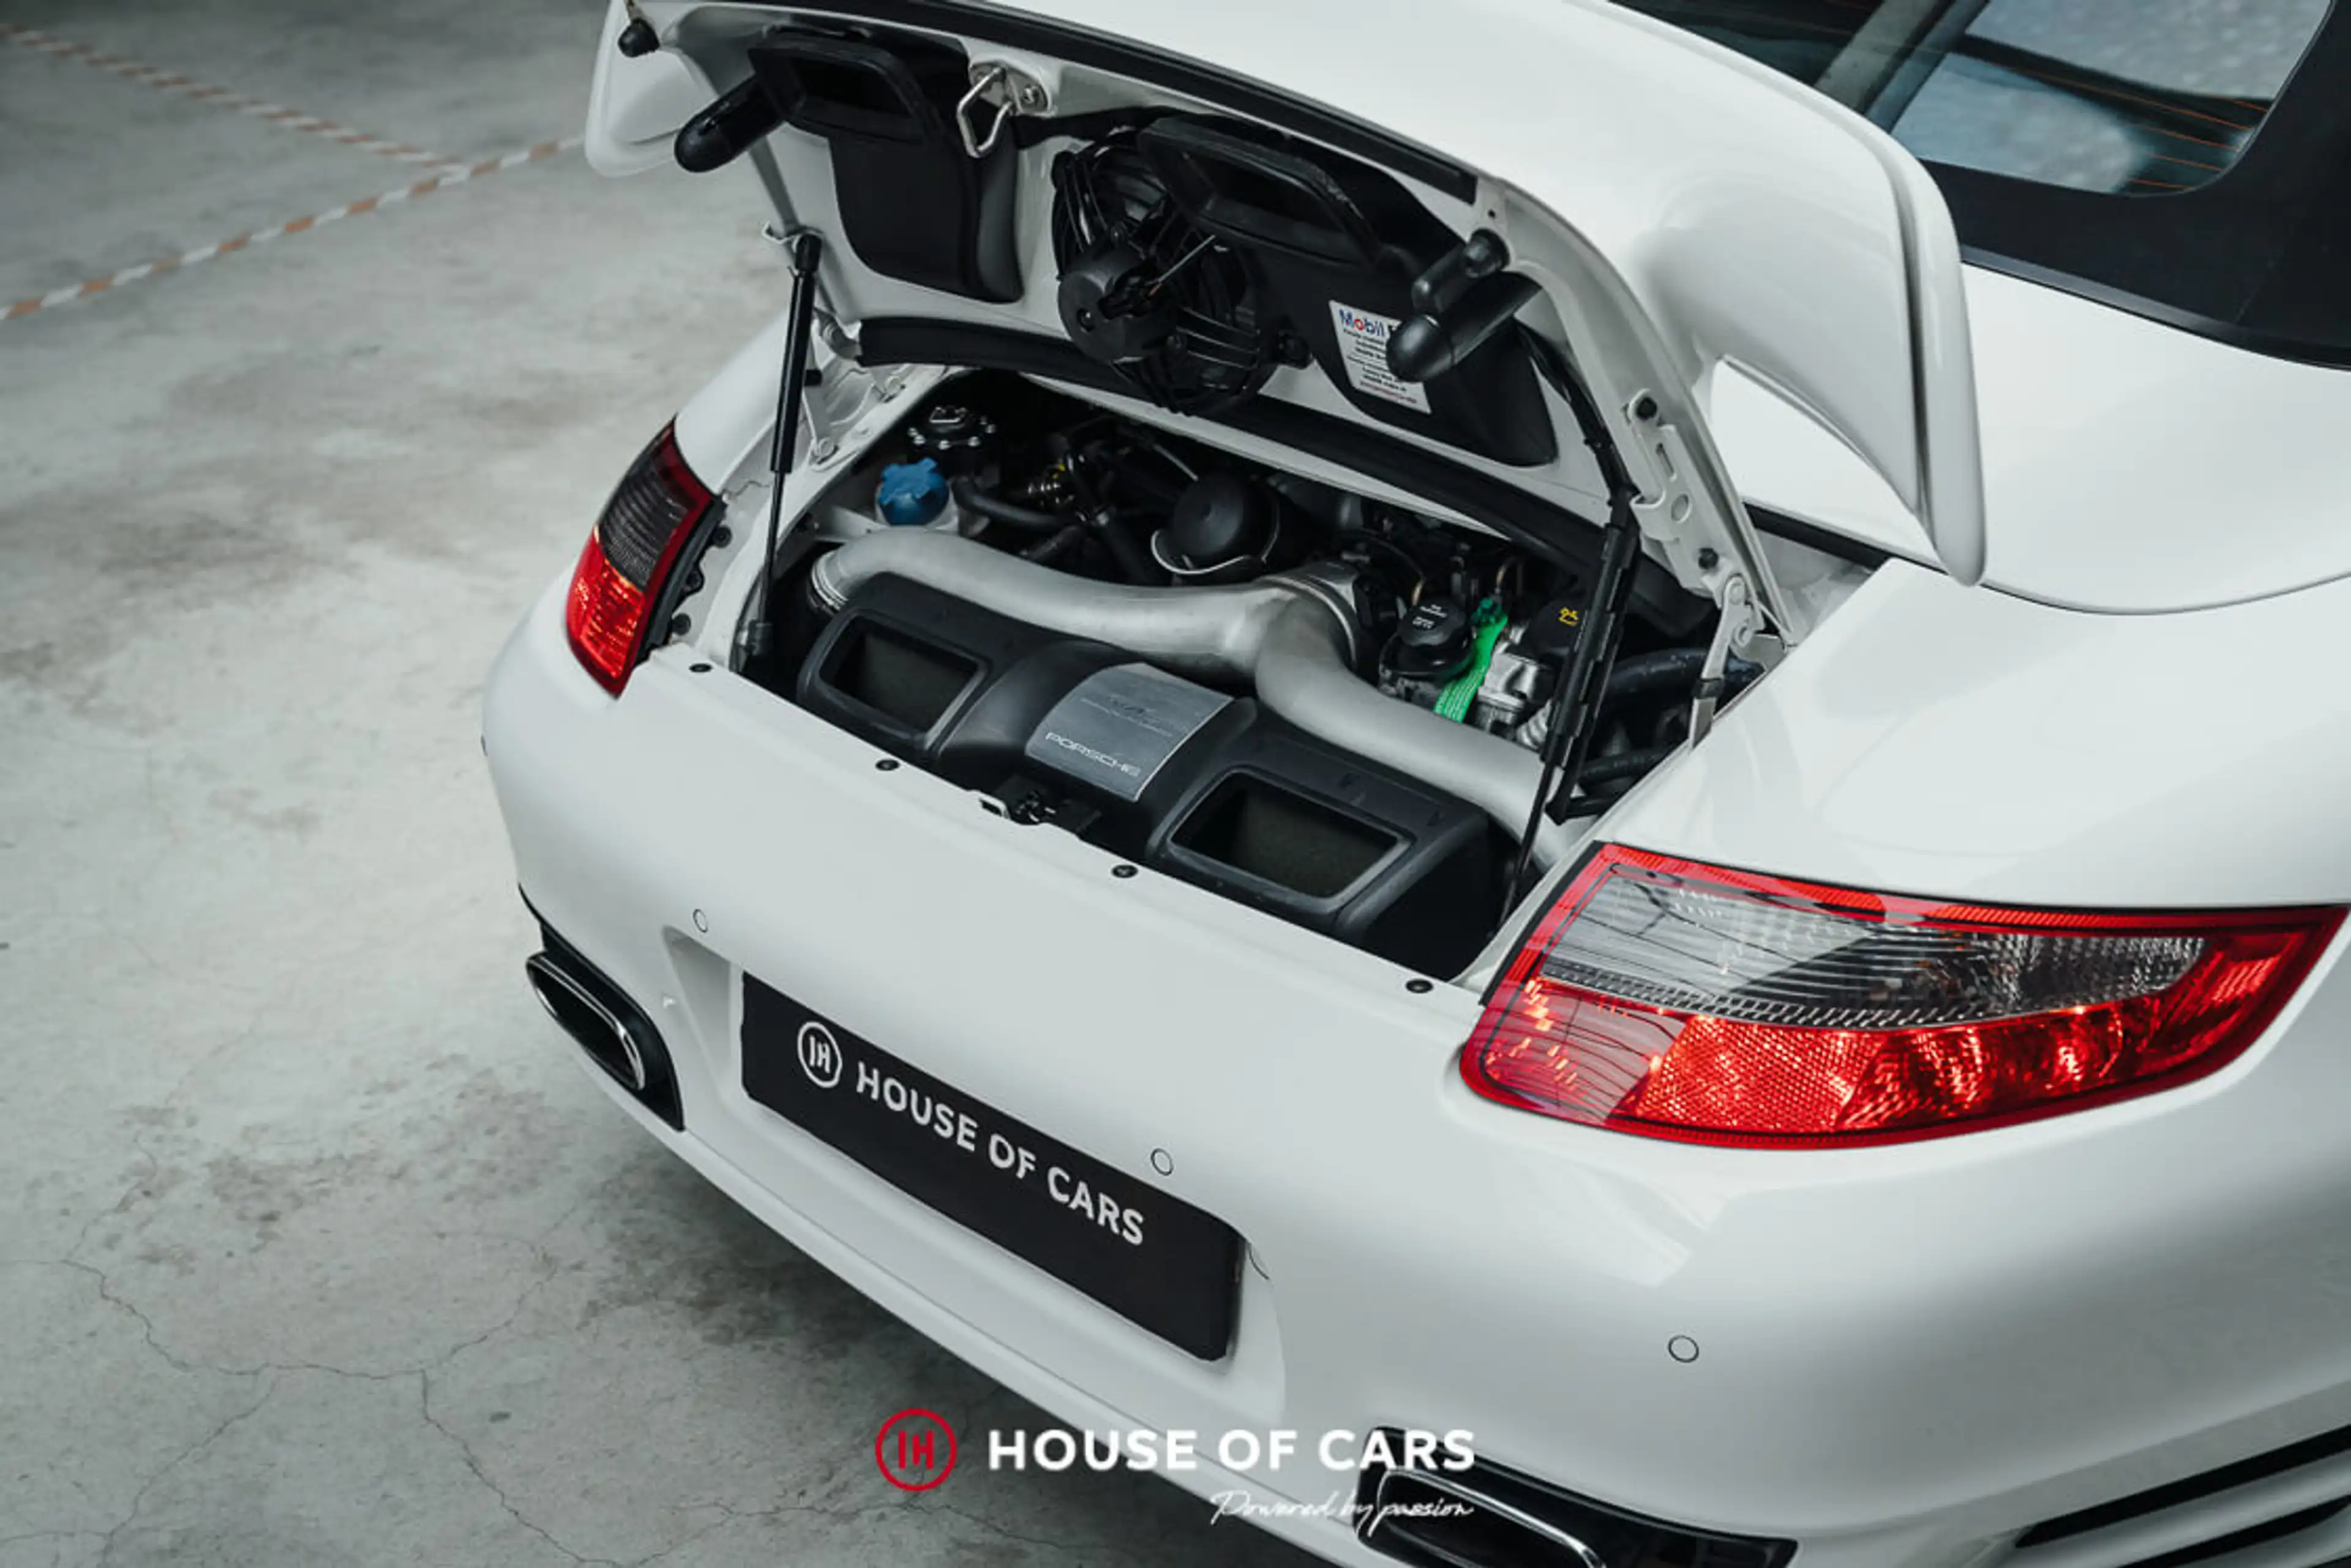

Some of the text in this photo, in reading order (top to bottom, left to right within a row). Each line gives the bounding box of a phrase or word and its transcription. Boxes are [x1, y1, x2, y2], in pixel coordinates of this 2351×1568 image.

[1339, 308, 1385, 336] Mobil
[1045, 732, 1141, 778] PORSCHE
[856, 1060, 1144, 1246] HOUSE OF CARS
